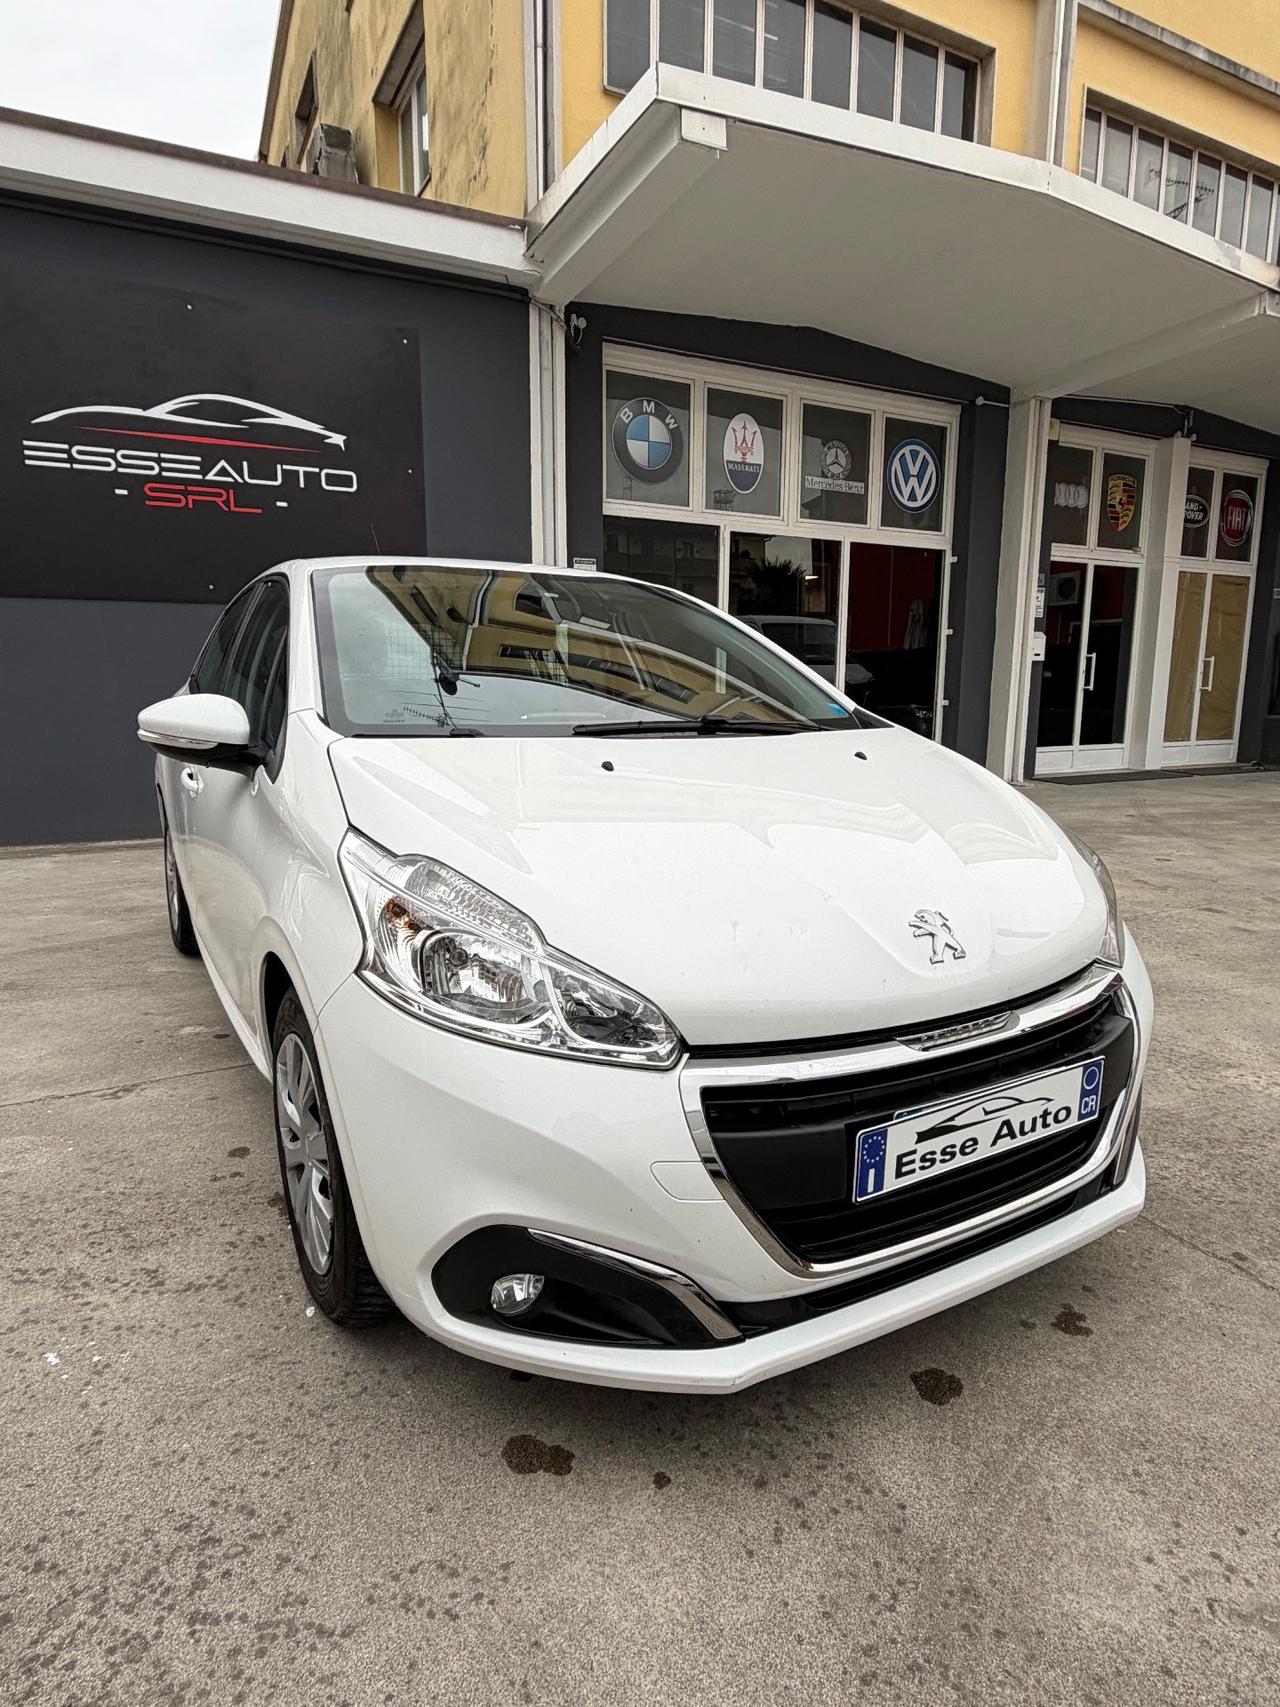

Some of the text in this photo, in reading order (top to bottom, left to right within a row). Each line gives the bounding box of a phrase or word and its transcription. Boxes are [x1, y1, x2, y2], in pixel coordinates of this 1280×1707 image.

[619, 400, 678, 430] BMW
[22, 440, 357, 493] ESSEAUTO
[727, 463, 760, 474] MASERATI
[144, 482, 262, 514] SRL
[1227, 506, 1248, 531] FIAT
[1081, 1095, 1097, 1114] CR
[895, 1105, 1072, 1180] Esse Auto
[867, 1168, 875, 1193] I
